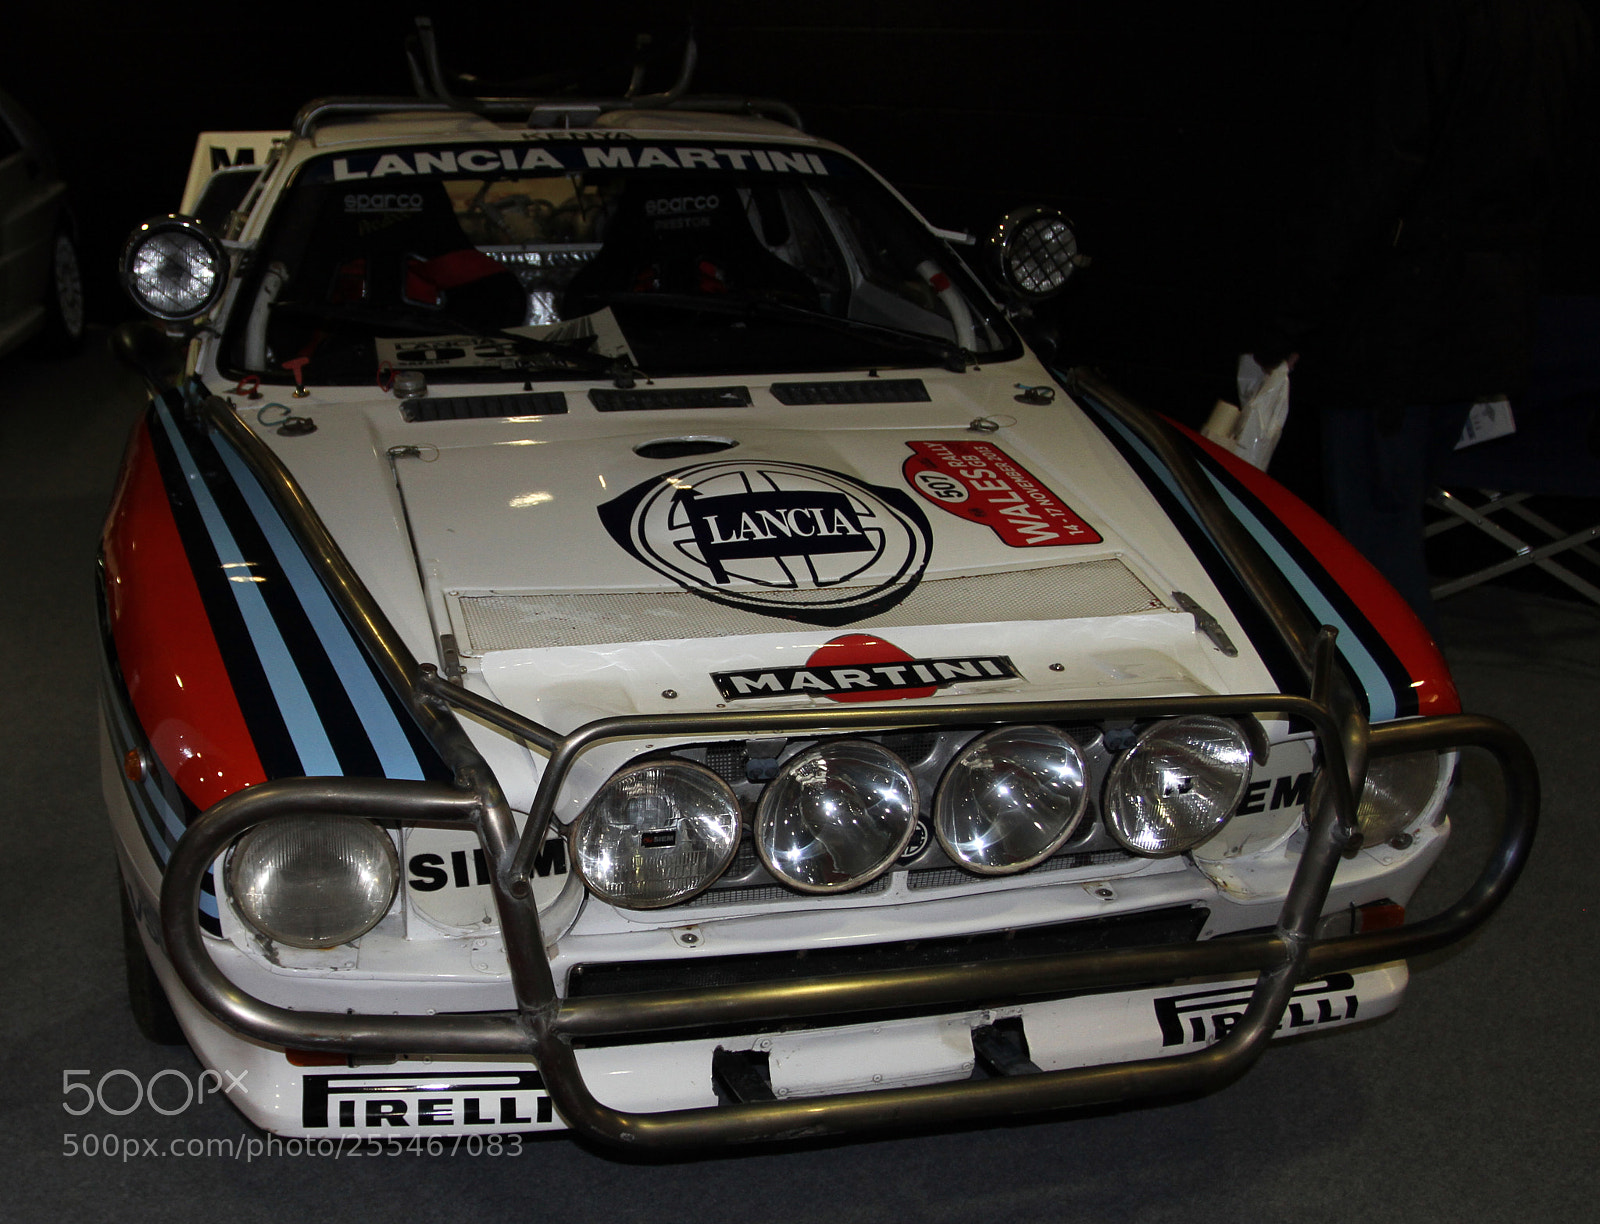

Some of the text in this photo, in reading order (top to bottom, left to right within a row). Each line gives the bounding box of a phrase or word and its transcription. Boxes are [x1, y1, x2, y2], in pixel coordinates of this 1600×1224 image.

[333, 147, 829, 182] LANCIA MARTINI
[344, 193, 423, 212] sparco
[646, 194, 719, 216] sparco
[922, 441, 968, 468] RALLY
[960, 454, 988, 468] GB
[972, 446, 1004, 462] 2013
[919, 474, 963, 499] 507
[993, 462, 1055, 507] NOVEMBER
[959, 468, 1060, 545] WALES
[1046, 508, 1065, 517] 17
[702, 507, 862, 545] LANCIA
[1062, 525, 1084, 536] 14
[729, 660, 1004, 695] MARTINI
[1154, 973, 1358, 1046] PIRLLI
[302, 1070, 552, 1128] PIRELLI
